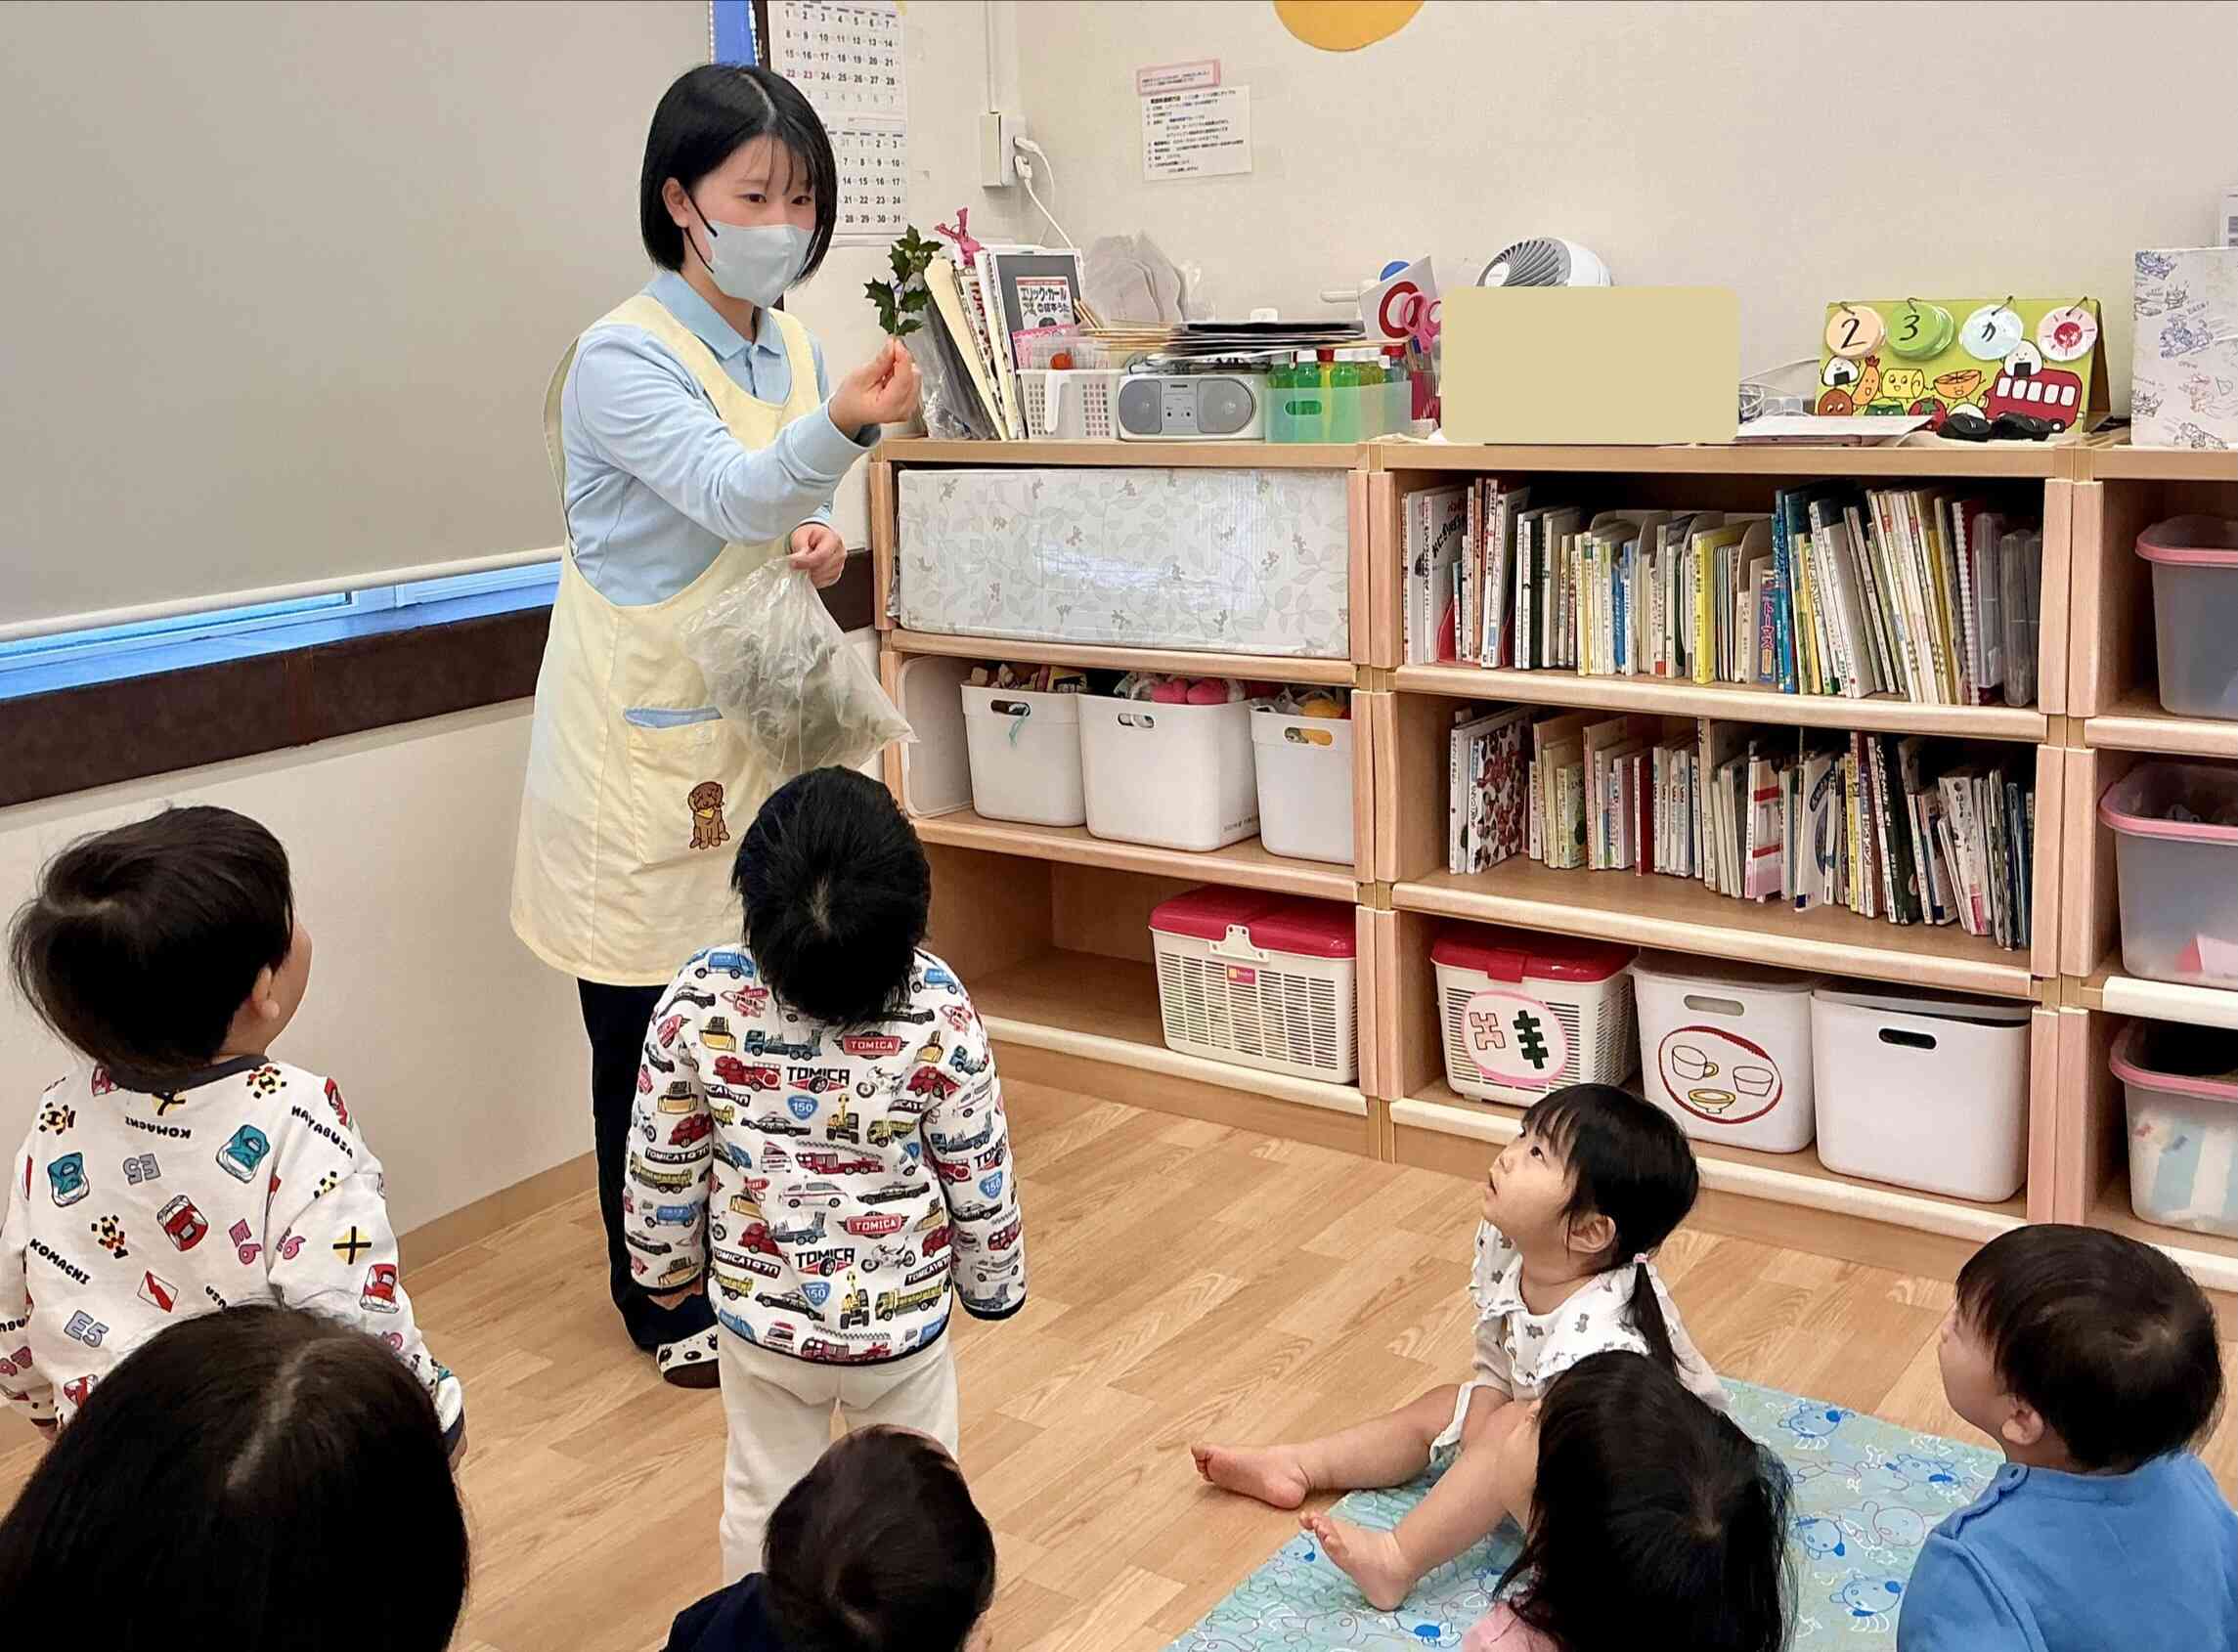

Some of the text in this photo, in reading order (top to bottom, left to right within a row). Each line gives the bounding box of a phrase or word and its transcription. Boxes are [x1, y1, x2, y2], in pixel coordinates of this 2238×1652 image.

[785, 9, 789, 18] 1
[803, 11, 808, 20] 2
[820, 13, 825, 22] 3
[838, 15, 843, 23] 4
[854, 17, 858, 25] 5
[885, 20, 890, 29] 7
[804, 31, 809, 40] 9
[819, 33, 828, 42] 10
[837, 34, 845, 43] 11
[853, 36, 860, 45] 12
[785, 49, 794, 59] 15
[803, 51, 812, 60] 16
[869, 57, 878, 65] 20
[786, 68, 895, 86] 22 23 24 25 26 27 28
[875, 140, 881, 149] 2
[877, 158, 882, 167] 9
[859, 177, 868, 186] 15
[876, 177, 884, 186] 16
[844, 196, 852, 204] 21
[859, 196, 868, 204] 22
[845, 214, 900, 224] 28 29 30 31
[1841, 318, 1866, 349] 2
[1899, 314, 1920, 341] 3
[851, 1040, 894, 1050] TOMICA
[786, 1066, 851, 1086] TOMICA
[792, 1102, 813, 1113] 150
[125, 1115, 192, 1140] KOMACHI
[290, 1106, 353, 1159] HAYABUSA
[122, 1152, 161, 1186] E5
[985, 1178, 1001, 1193] 150
[856, 1219, 897, 1231] TOMICA
[29, 1238, 91, 1285] KOMACHI
[795, 1247, 856, 1269] TOMICA
[808, 1288, 826, 1300] 150
[64, 1309, 110, 1348] E5
